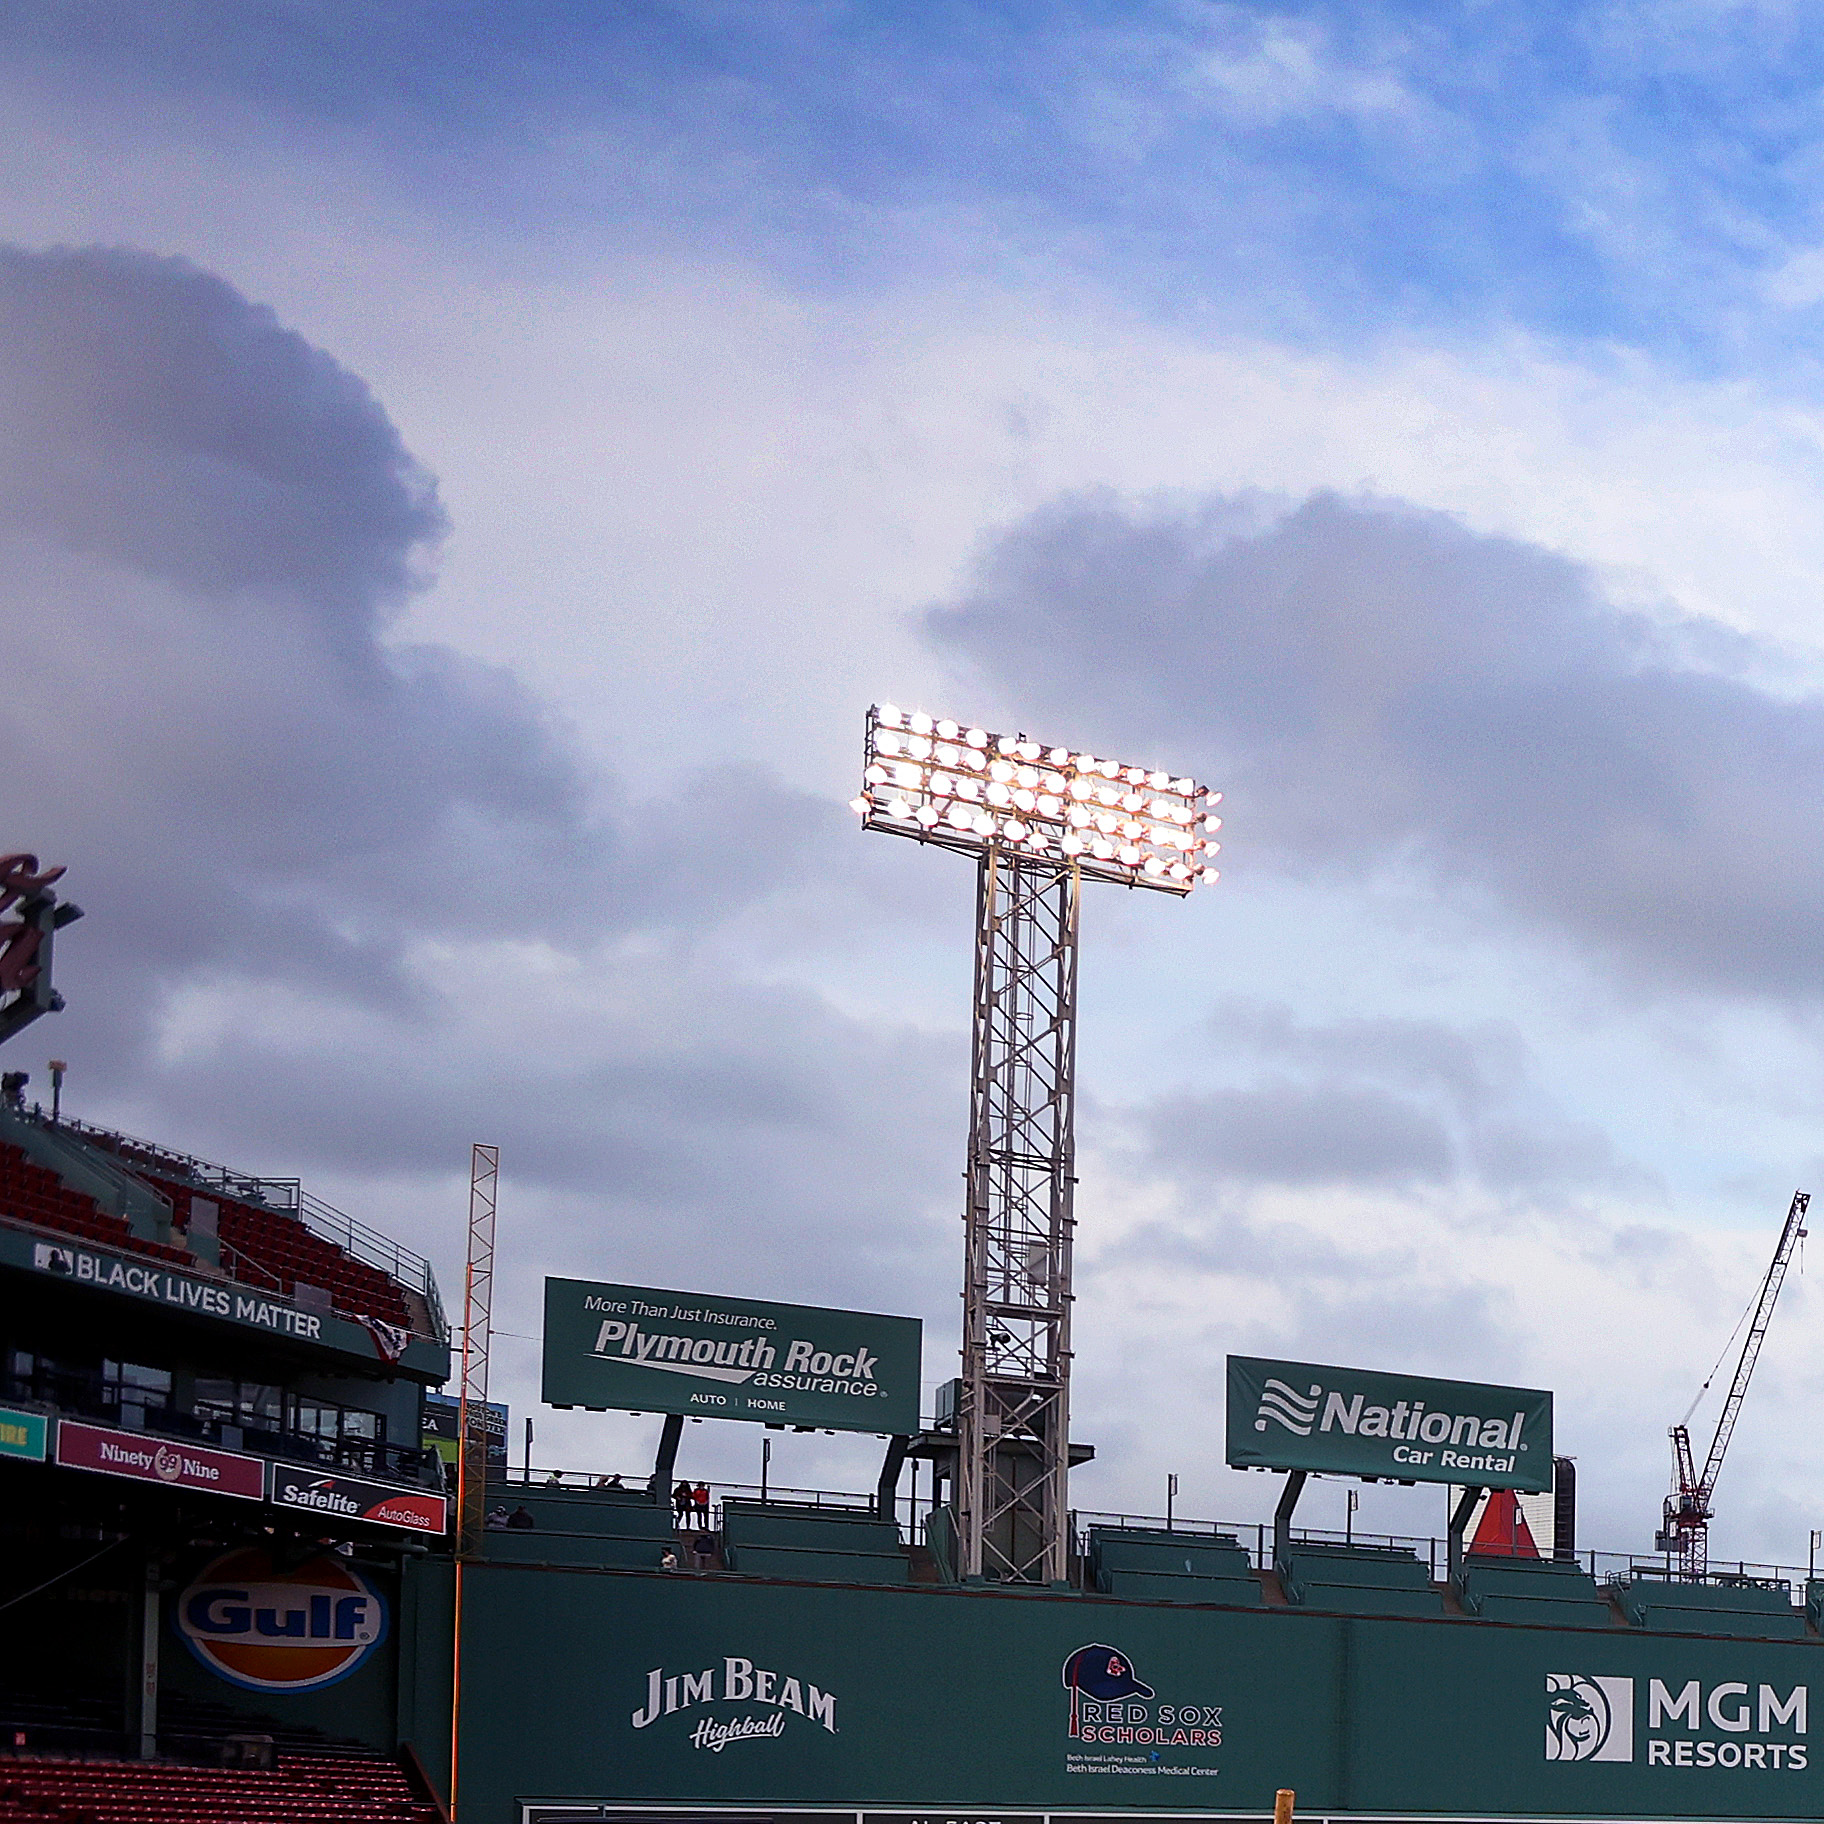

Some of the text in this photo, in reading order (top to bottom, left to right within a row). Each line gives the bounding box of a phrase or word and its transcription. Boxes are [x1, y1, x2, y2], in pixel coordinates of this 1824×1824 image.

[78, 1255, 321, 1340] BLACK LIVES MATTER
[584, 1295, 778, 1331] More Than Just Insurance.
[595, 1319, 878, 1379] Plymouth Rock
[690, 1393, 786, 1411] AUTO HOME
[753, 1371, 878, 1397] assurance
[100, 1443, 219, 1480] Ninety 99 Nine
[1393, 1446, 1515, 1472] Car Rental
[283, 1485, 430, 1527] Safelite AutoGlass
[187, 1589, 367, 1639] Gulf
[632, 1657, 838, 1735] JIM BEAM
[1649, 1678, 1807, 1734] MGM
[689, 1712, 785, 1753] Highball
[1083, 1703, 1222, 1727] RED SOX
[1081, 1725, 1222, 1747] SCHOLARS
[1066, 1764, 1219, 1777] Beth Israel Deaconess Medical Center
[1648, 1739, 1808, 1770] RESORTS
